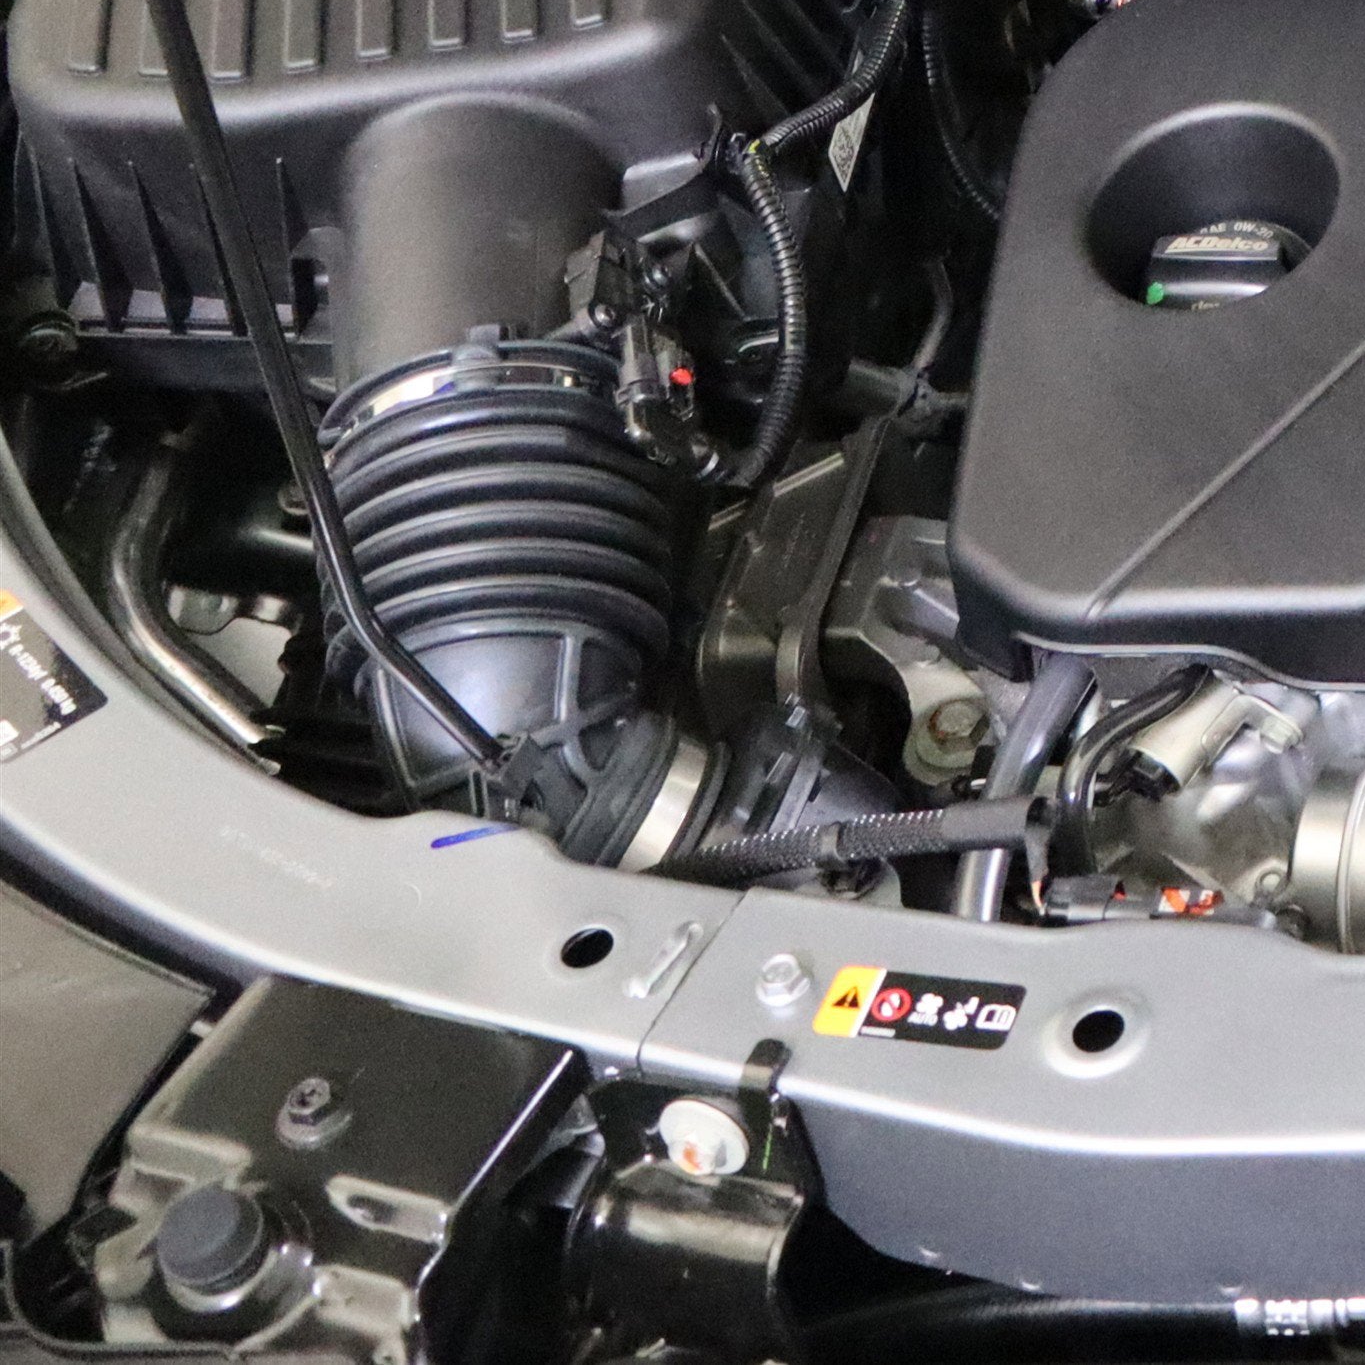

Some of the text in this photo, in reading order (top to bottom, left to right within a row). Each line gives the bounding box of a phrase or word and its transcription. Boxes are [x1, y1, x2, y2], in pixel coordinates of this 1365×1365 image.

[1233, 221, 1274, 239] 0W-20
[1165, 236, 1269, 252] ACDelco
[907, 1011, 938, 1026] AUTO
